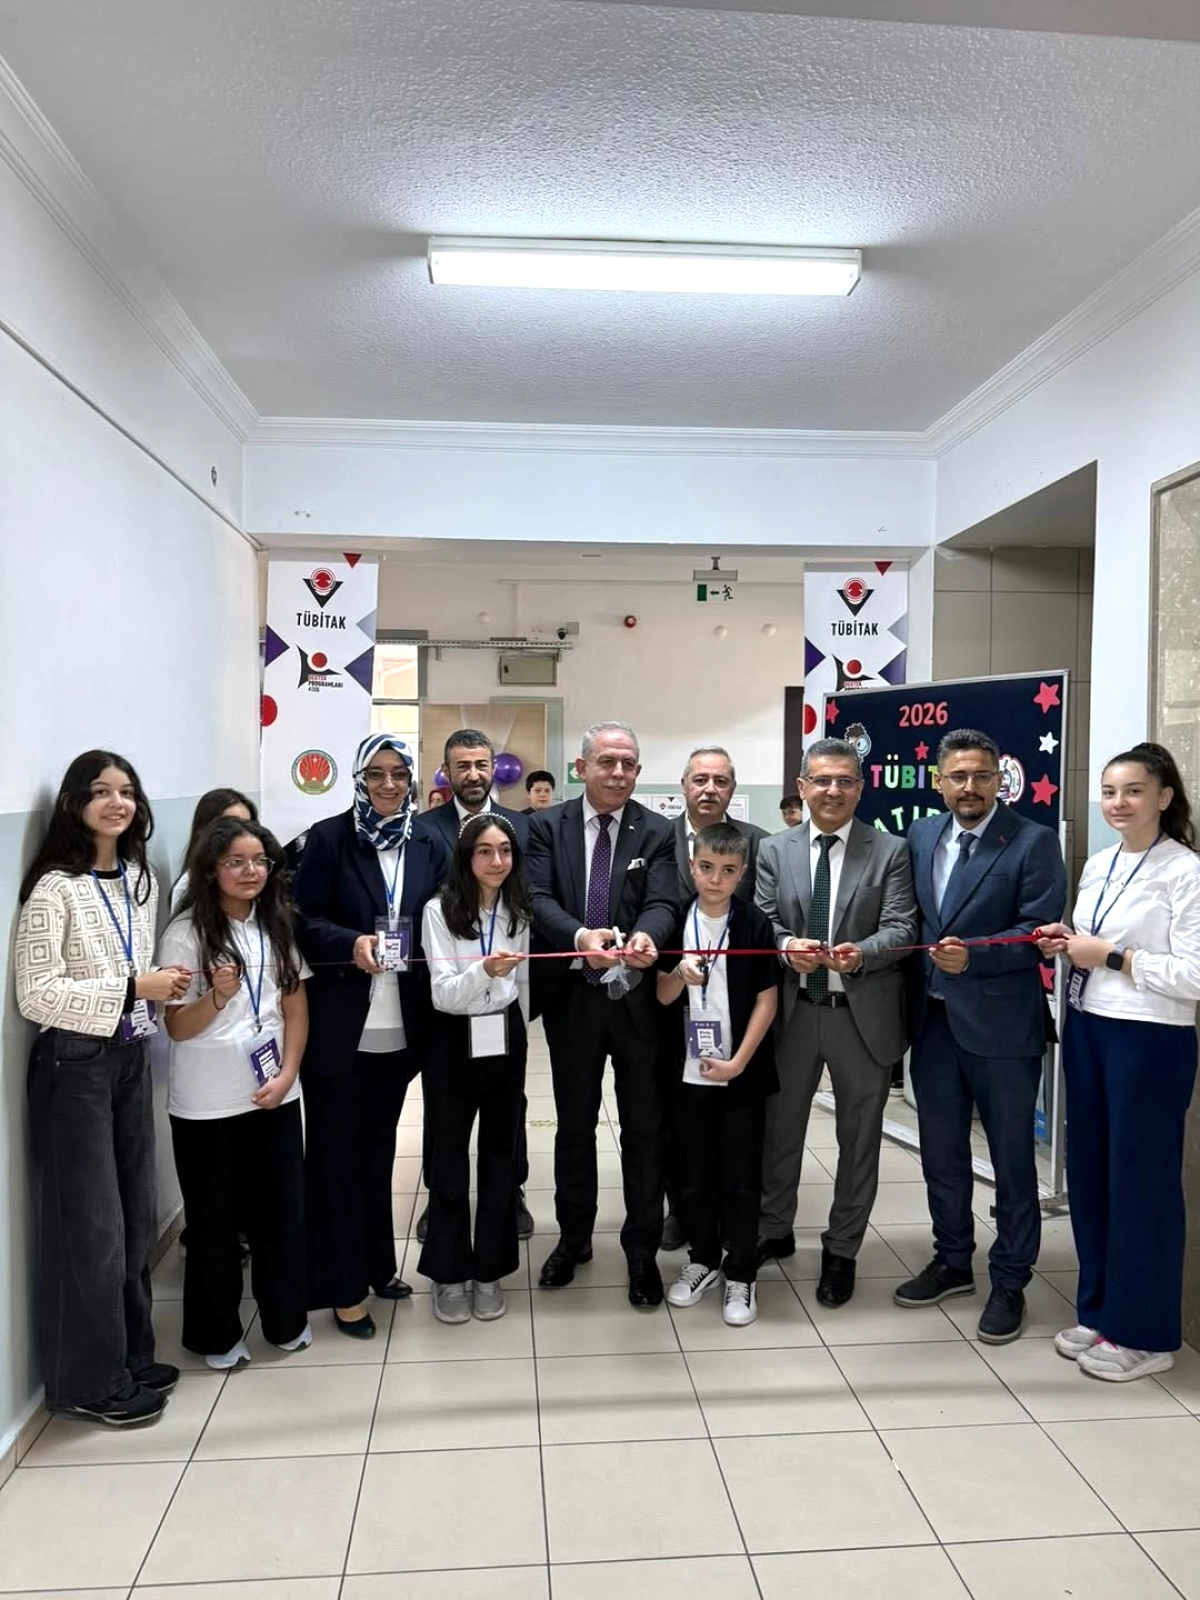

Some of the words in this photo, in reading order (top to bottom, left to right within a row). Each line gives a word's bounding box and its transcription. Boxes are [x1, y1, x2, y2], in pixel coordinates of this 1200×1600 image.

[296, 611, 347, 630] TÜBİTAK
[831, 620, 879, 636] TÜBİTAK
[899, 701, 949, 728] 2026
[870, 752, 939, 790] TÜBİT
